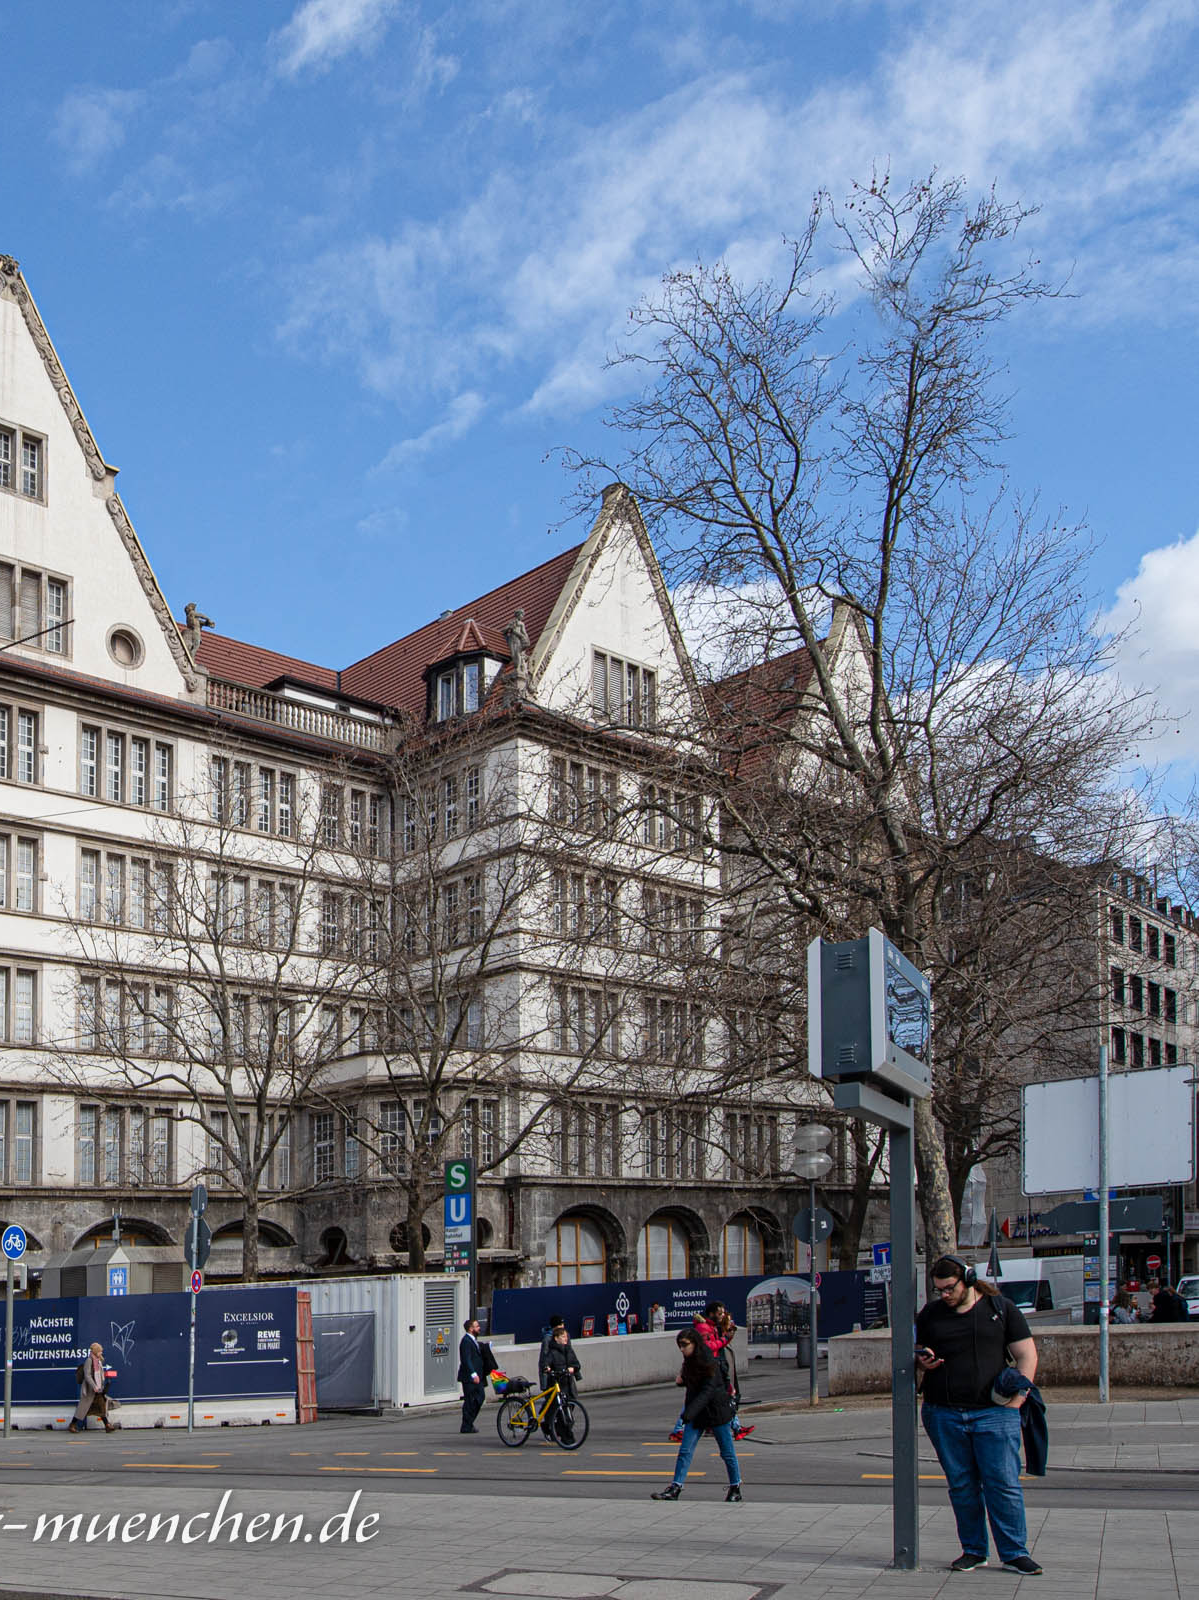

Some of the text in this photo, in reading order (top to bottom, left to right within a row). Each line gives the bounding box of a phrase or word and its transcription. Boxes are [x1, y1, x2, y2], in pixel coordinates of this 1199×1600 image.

[450, 1164, 467, 1188] S
[450, 1197, 466, 1223] U
[672, 1290, 707, 1298] NÄCHSTER
[674, 1300, 706, 1308] EINGANG
[223, 1312, 274, 1322] EXCELSIOR
[29, 1317, 74, 1330] NÄCHSTER
[31, 1333, 72, 1344] EINGANG
[257, 1330, 281, 1339] REWE
